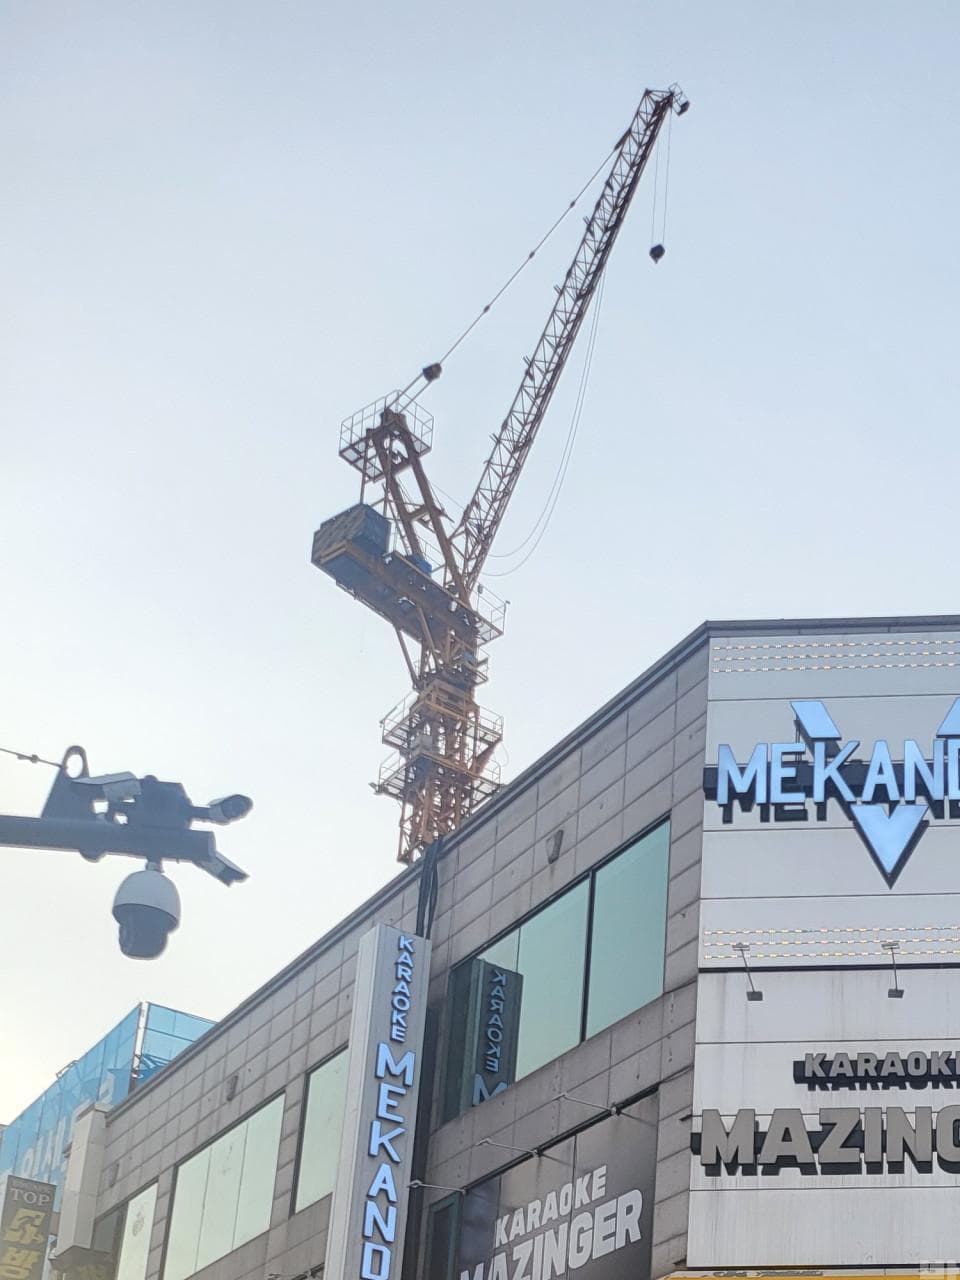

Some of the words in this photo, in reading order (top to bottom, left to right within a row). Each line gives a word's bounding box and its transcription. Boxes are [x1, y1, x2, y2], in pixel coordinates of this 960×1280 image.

[391, 935, 415, 1043] KARAOKE
[9, 1187, 52, 1207] TOP
[494, 1165, 608, 1248] KARAOKE
